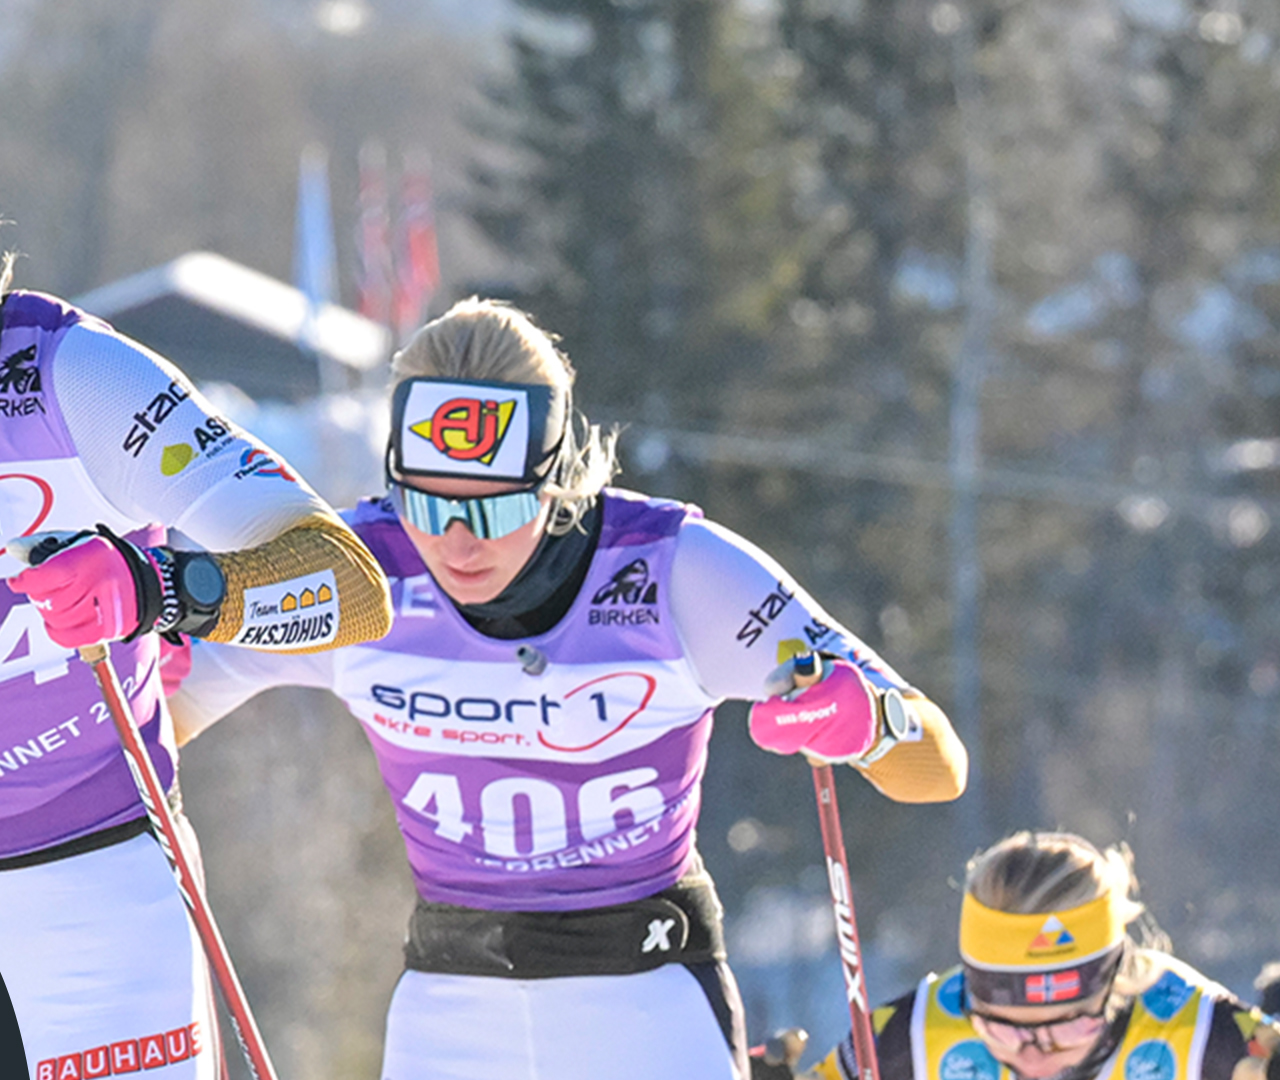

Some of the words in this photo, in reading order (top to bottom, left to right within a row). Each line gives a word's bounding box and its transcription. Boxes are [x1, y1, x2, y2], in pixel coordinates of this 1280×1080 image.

[193, 414, 232, 452] AS
[250, 597, 278, 619] Team
[588, 608, 659, 626] BIRKEN
[371, 683, 561, 725] sport
[590, 691, 608, 721] 1
[401, 767, 667, 858] 406
[827, 856, 866, 1014] SWIX
